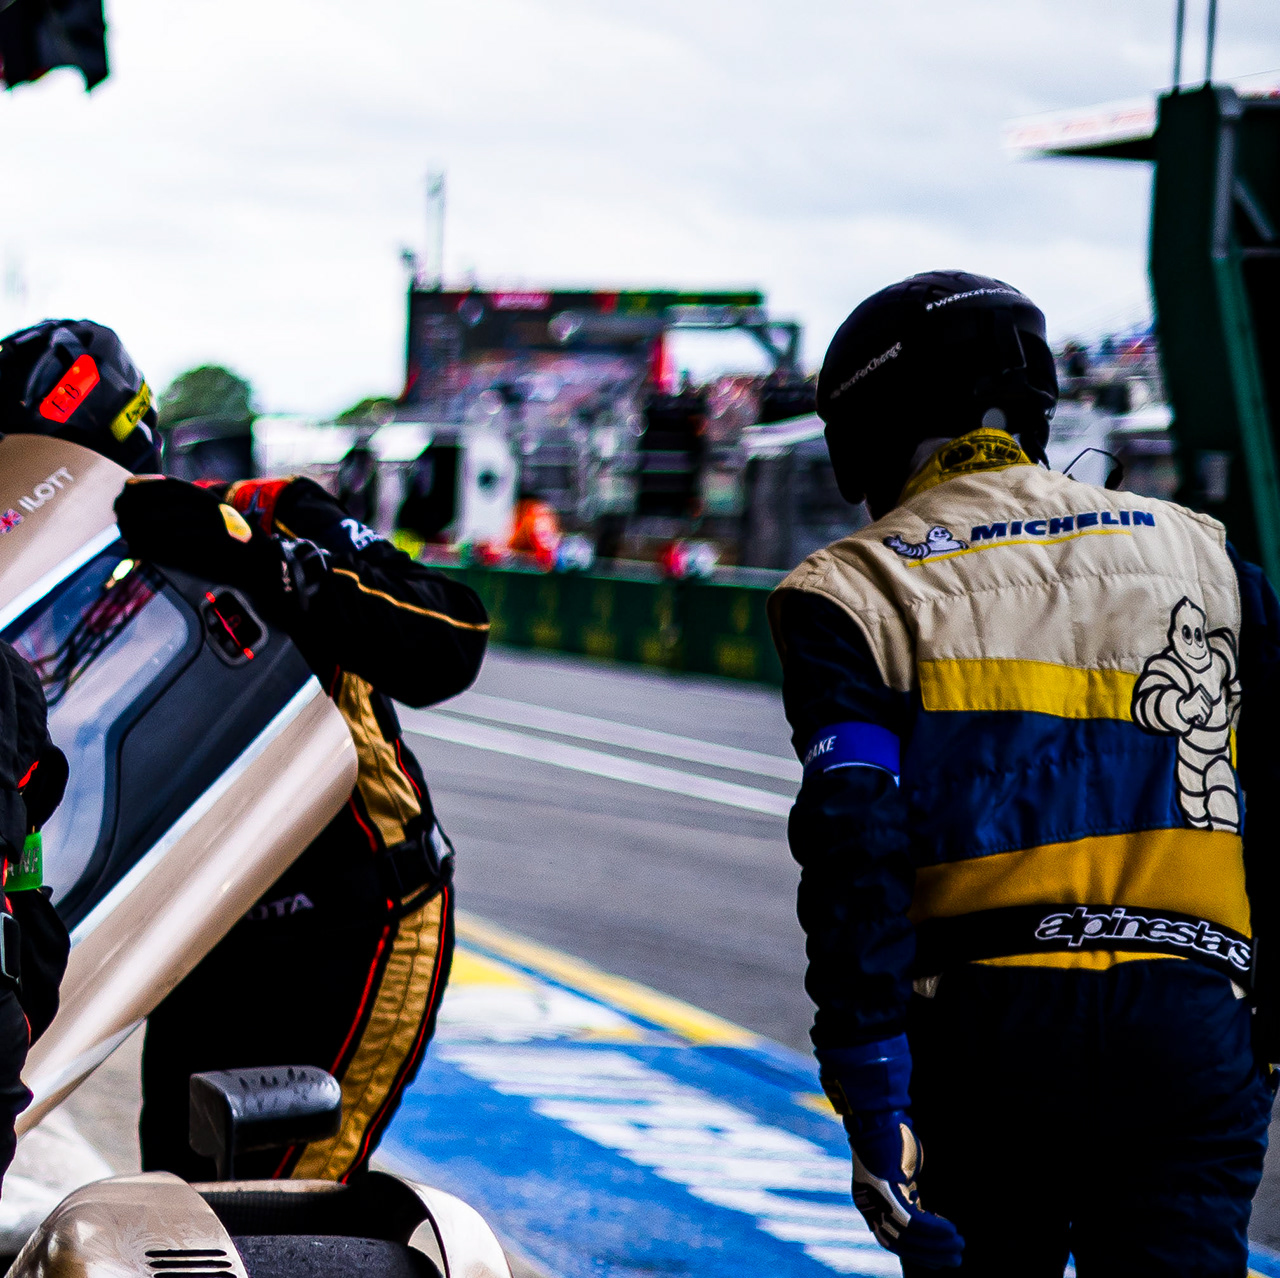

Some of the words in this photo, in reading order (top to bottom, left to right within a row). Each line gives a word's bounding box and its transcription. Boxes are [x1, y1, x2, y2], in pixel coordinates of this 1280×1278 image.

[18, 466, 75, 512] ILOTT
[970, 509, 1157, 542] MICHELIN
[246, 892, 316, 922] OTA
[1035, 906, 1252, 972] alpinestars
